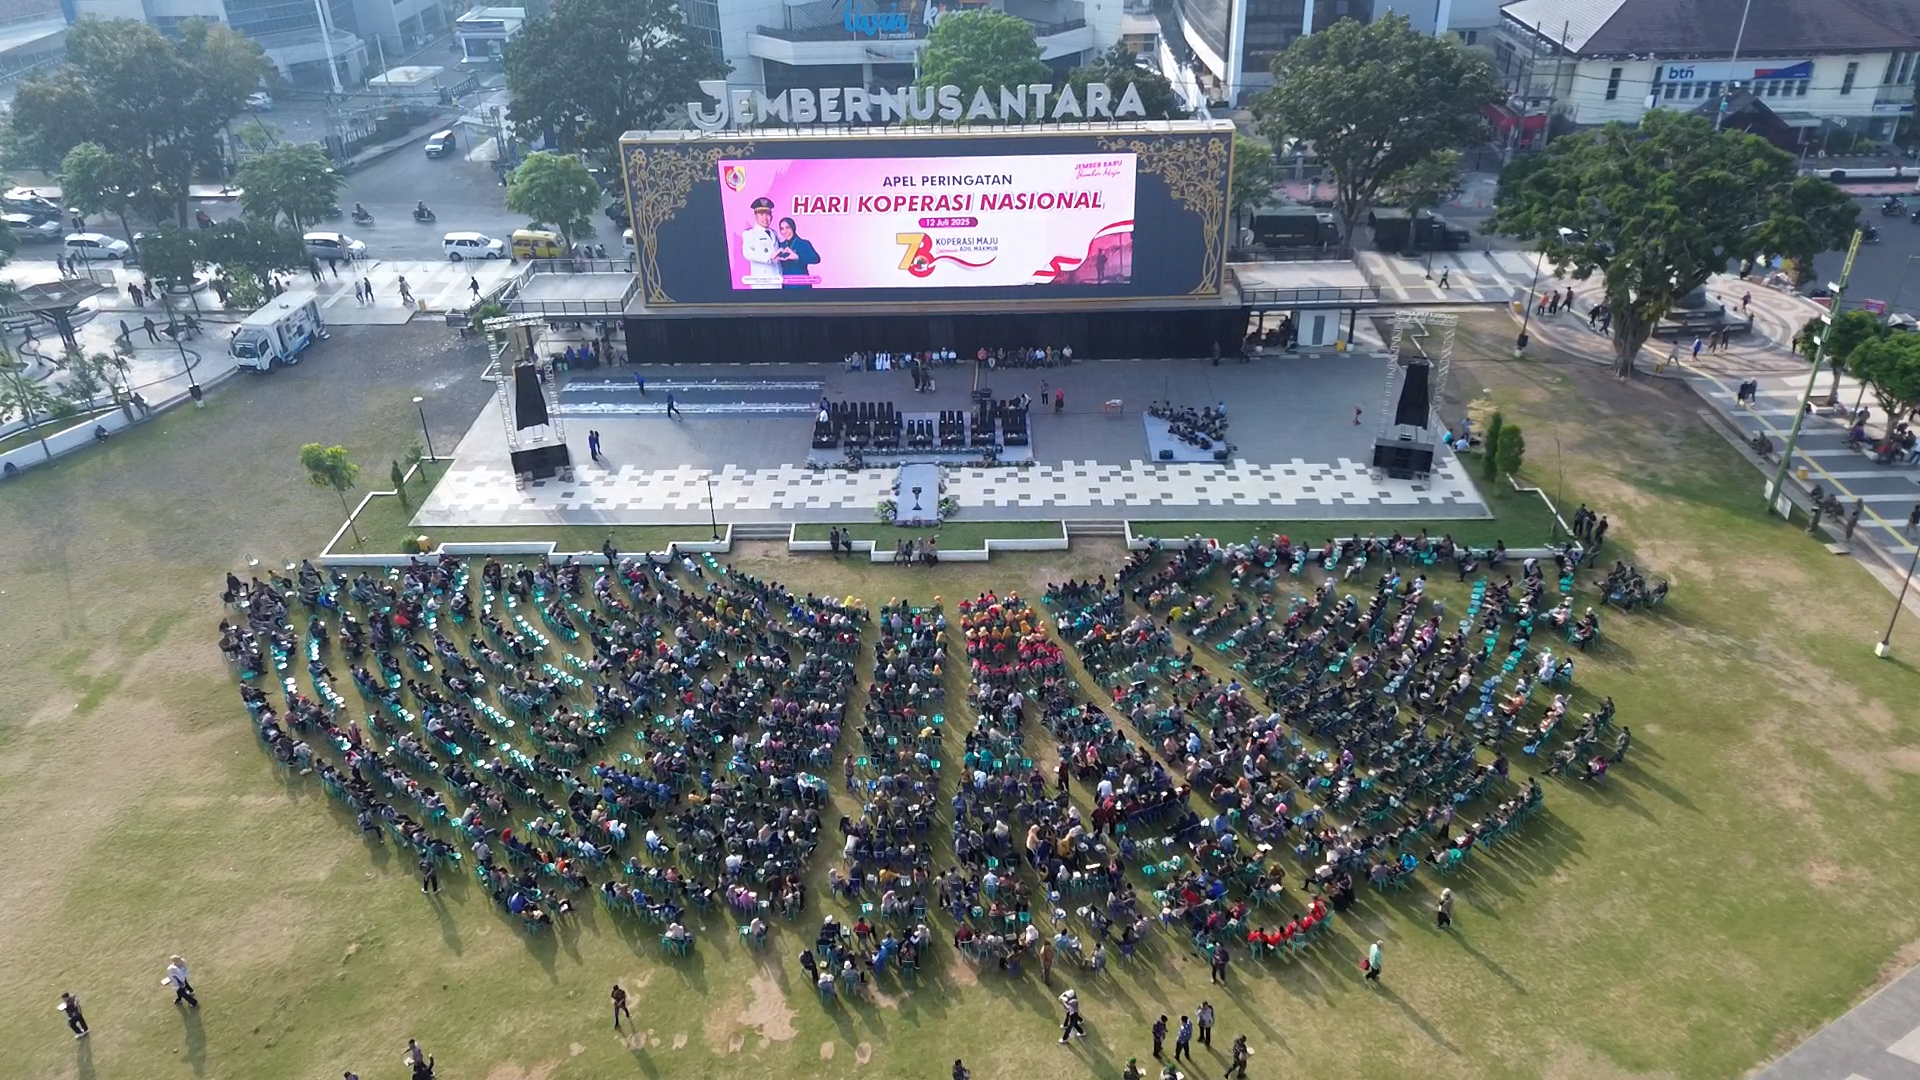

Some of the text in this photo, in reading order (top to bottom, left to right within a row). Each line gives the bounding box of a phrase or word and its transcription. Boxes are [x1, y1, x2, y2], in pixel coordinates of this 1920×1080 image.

[1669, 65, 1695, 79] btn
[687, 80, 1147, 129] JEMBER NUSANTARA
[882, 174, 1013, 187] APEL PERINGATAN
[793, 191, 1103, 214] HARI KOPERASI NASIONAL
[926, 218, 970, 226] 12 Juli 2025
[935, 237, 998, 246] KOPERASI MAJU
